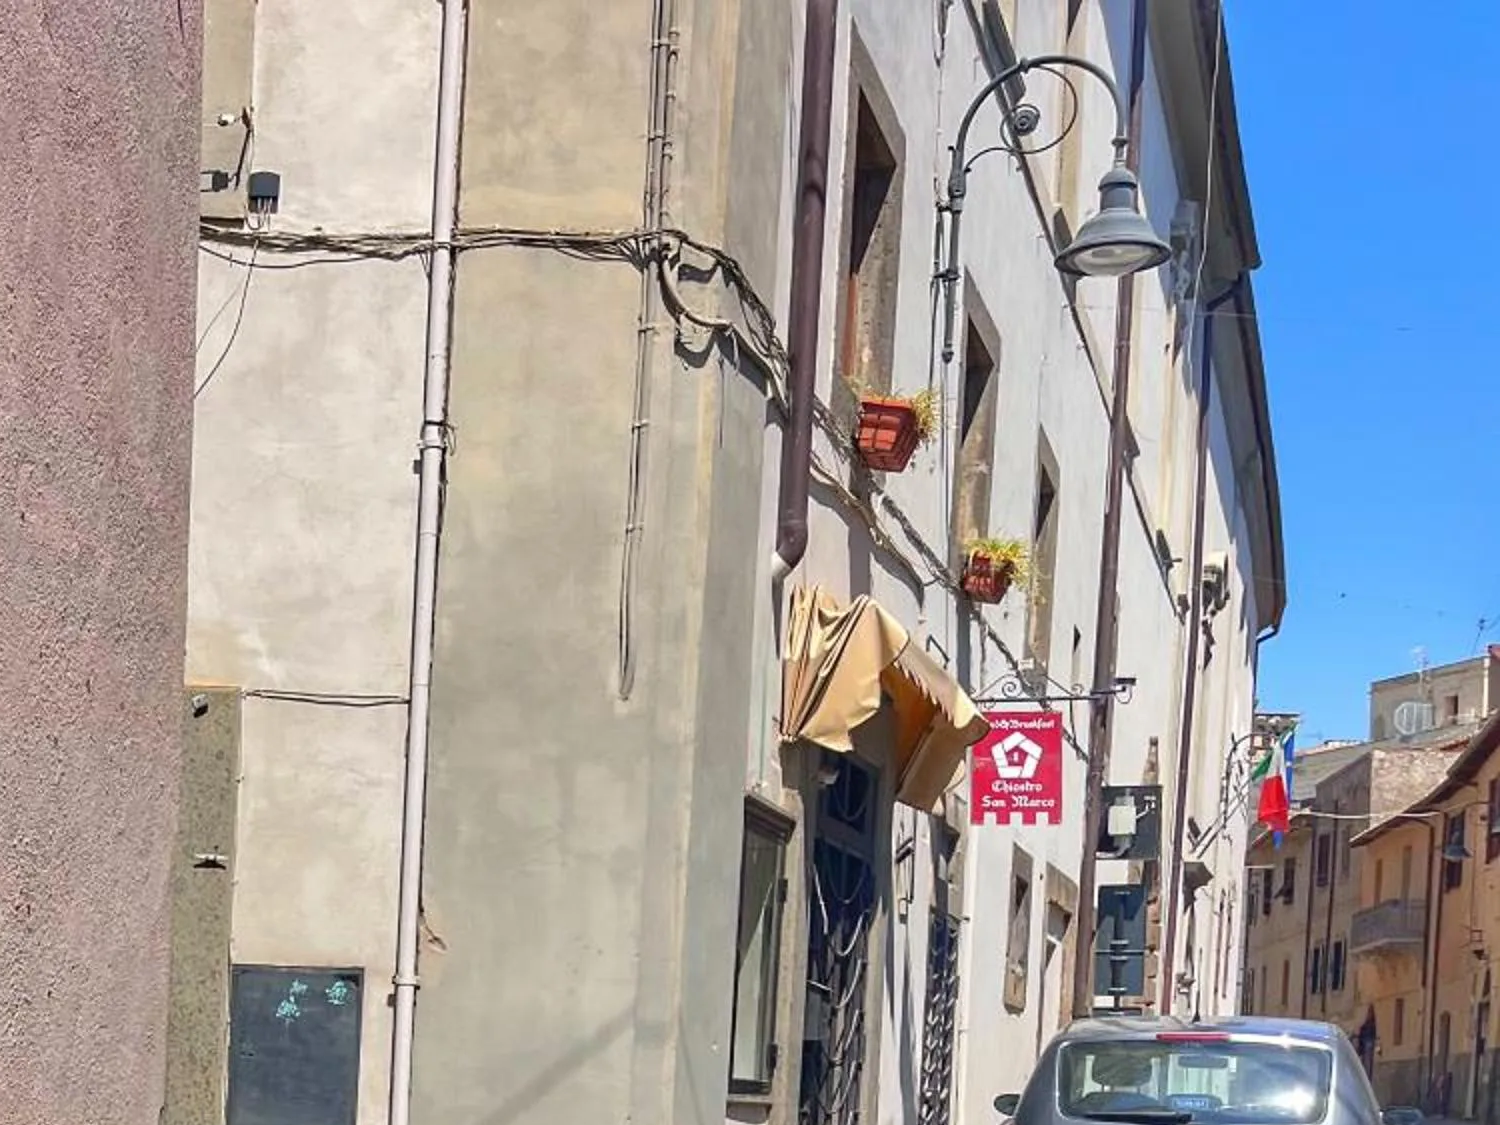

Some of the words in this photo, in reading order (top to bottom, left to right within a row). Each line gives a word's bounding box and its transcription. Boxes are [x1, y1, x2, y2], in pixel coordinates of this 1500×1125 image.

[991, 780, 1042, 793] Chiostro
[981, 795, 1006, 807] San
[1011, 795, 1055, 808] Marco
